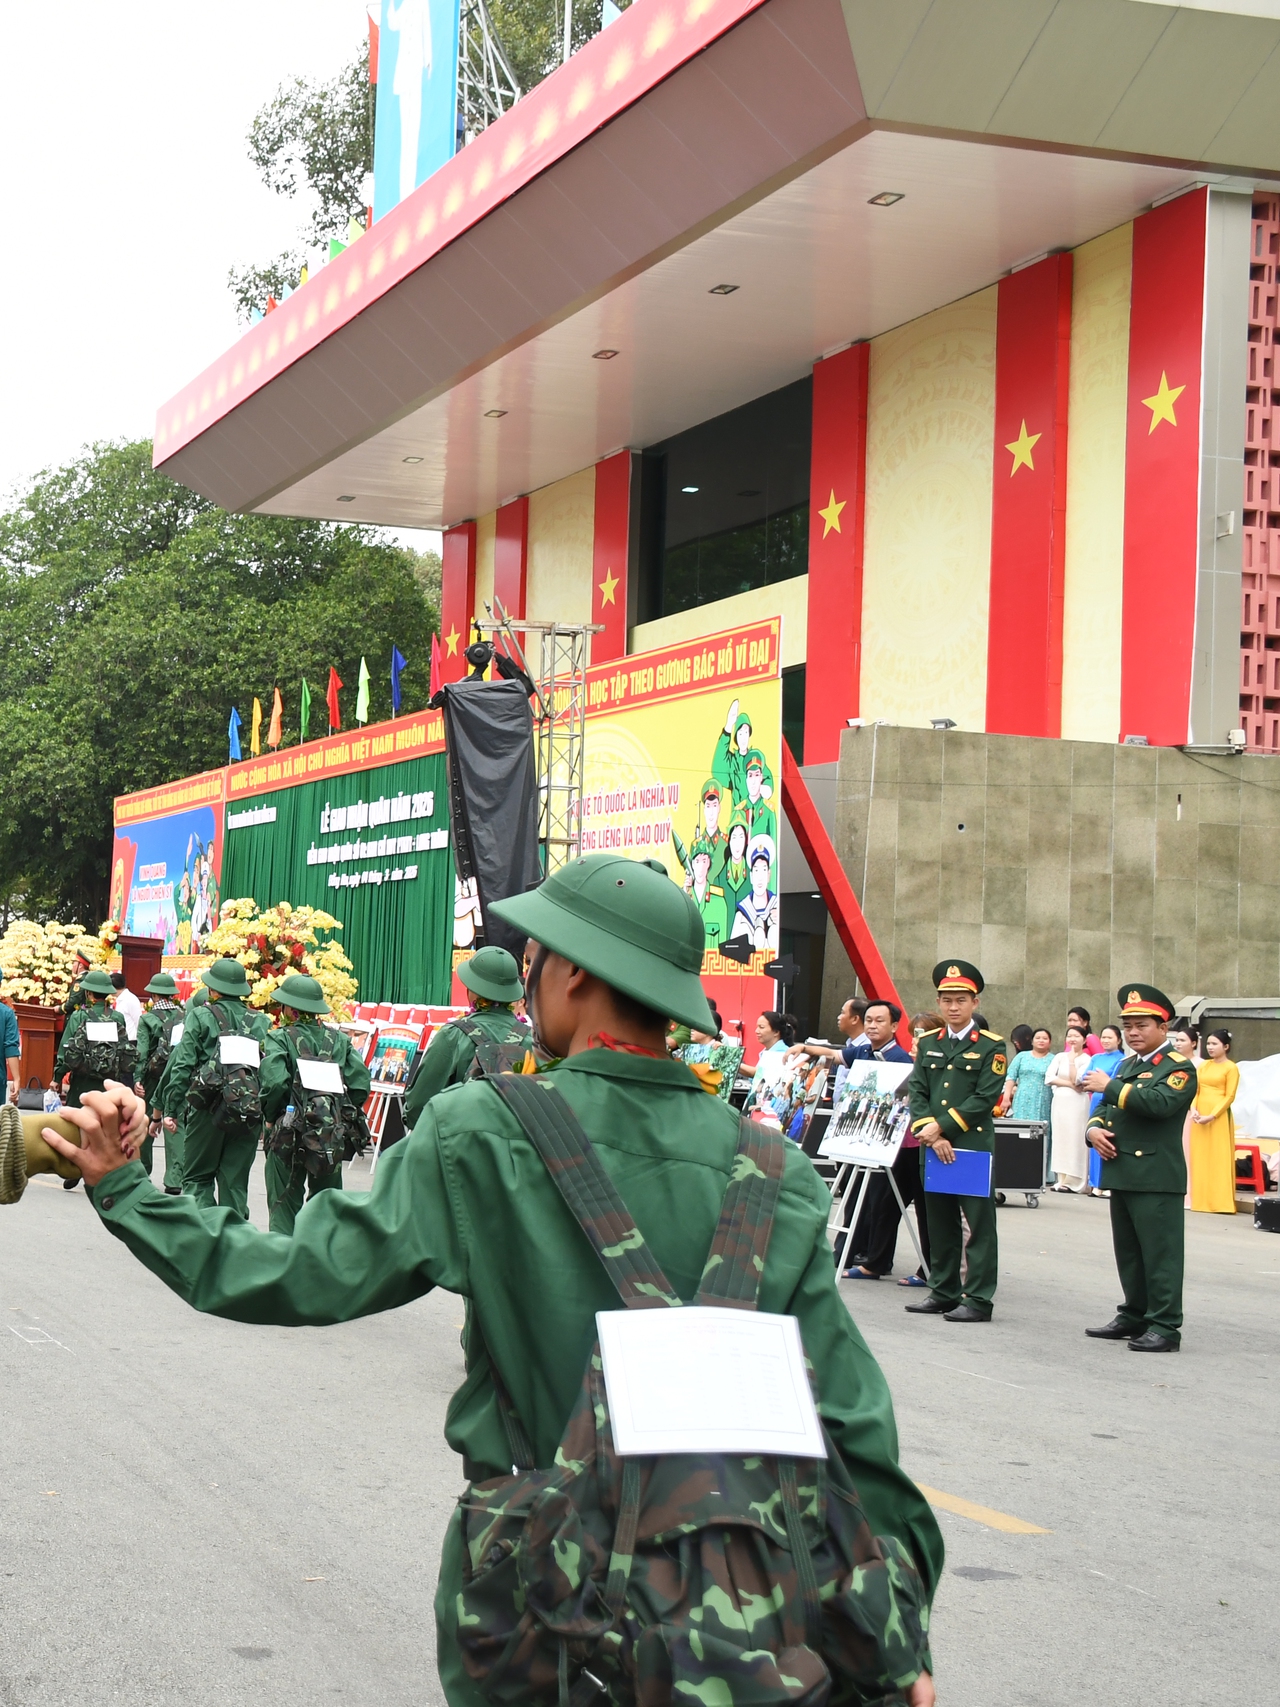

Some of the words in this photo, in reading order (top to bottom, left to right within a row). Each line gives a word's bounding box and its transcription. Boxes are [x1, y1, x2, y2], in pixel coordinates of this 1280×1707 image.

[590, 682, 608, 708] HỌC
[610, 674, 628, 704] TẬP
[630, 666, 653, 697] THEO
[656, 660, 690, 691] GƯƠNG
[693, 649, 715, 682] BÁC
[718, 638, 733, 674] HỒ
[735, 638, 748, 671] VĨ
[749, 637, 770, 672] ĐẠI
[249, 764, 267, 789] CỘNG
[282, 757, 293, 779] XÃ
[294, 752, 306, 778] HỘI
[308, 745, 324, 771] CHỦ
[325, 741, 350, 768] NGHĨA
[352, 736, 370, 763] VIỆT
[372, 733, 394, 757] NAM
[395, 723, 426, 750] MUÔN
[427, 716, 446, 743] NĂ
[593, 787, 603, 816] TỔ
[604, 786, 625, 816] QUỐC
[627, 786, 637, 811] LÀ
[640, 783, 666, 809] NGHĨA
[668, 784, 679, 811] VỤ
[598, 824, 621, 849] LIÊNG
[623, 823, 634, 847] VÀ
[636, 825, 651, 844] CAO
[653, 819, 671, 844] QUÝ
